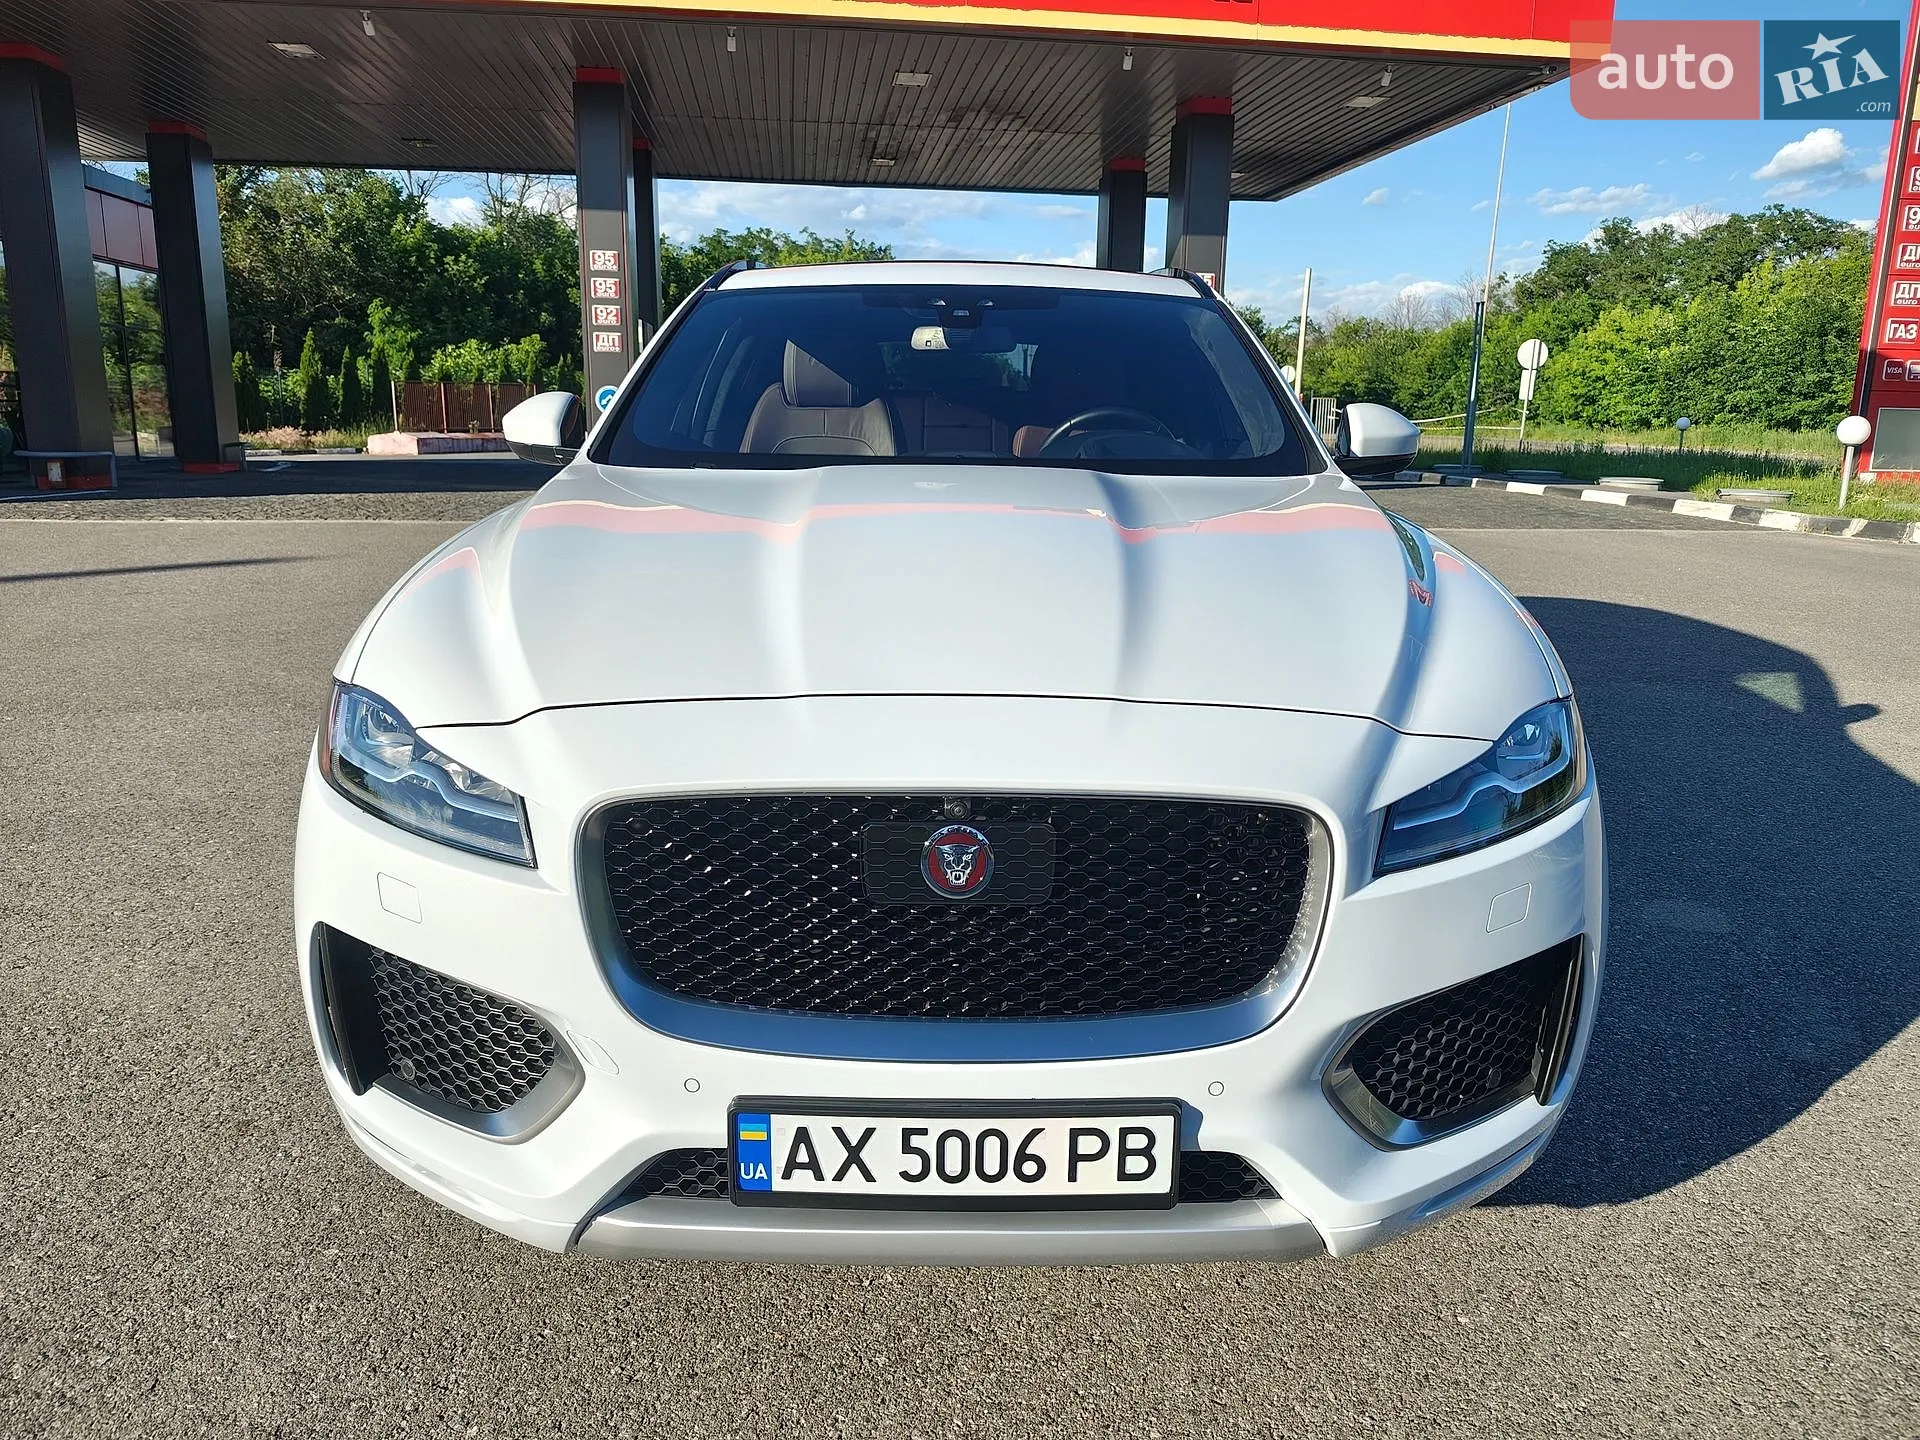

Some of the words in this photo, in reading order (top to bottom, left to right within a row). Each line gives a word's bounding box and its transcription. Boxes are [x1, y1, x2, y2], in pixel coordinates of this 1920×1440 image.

[1909, 207, 1920, 225] 9
[594, 252, 615, 266] 95
[595, 280, 616, 293] 95
[597, 308, 617, 320] 92
[1889, 323, 1918, 339] ГАЗ
[597, 335, 619, 347] ДП
[1887, 366, 1903, 374] VISA
[781, 1126, 877, 1183] AX
[898, 1127, 1047, 1184] 5006
[1067, 1127, 1157, 1183] PB
[740, 1162, 768, 1180] UA
